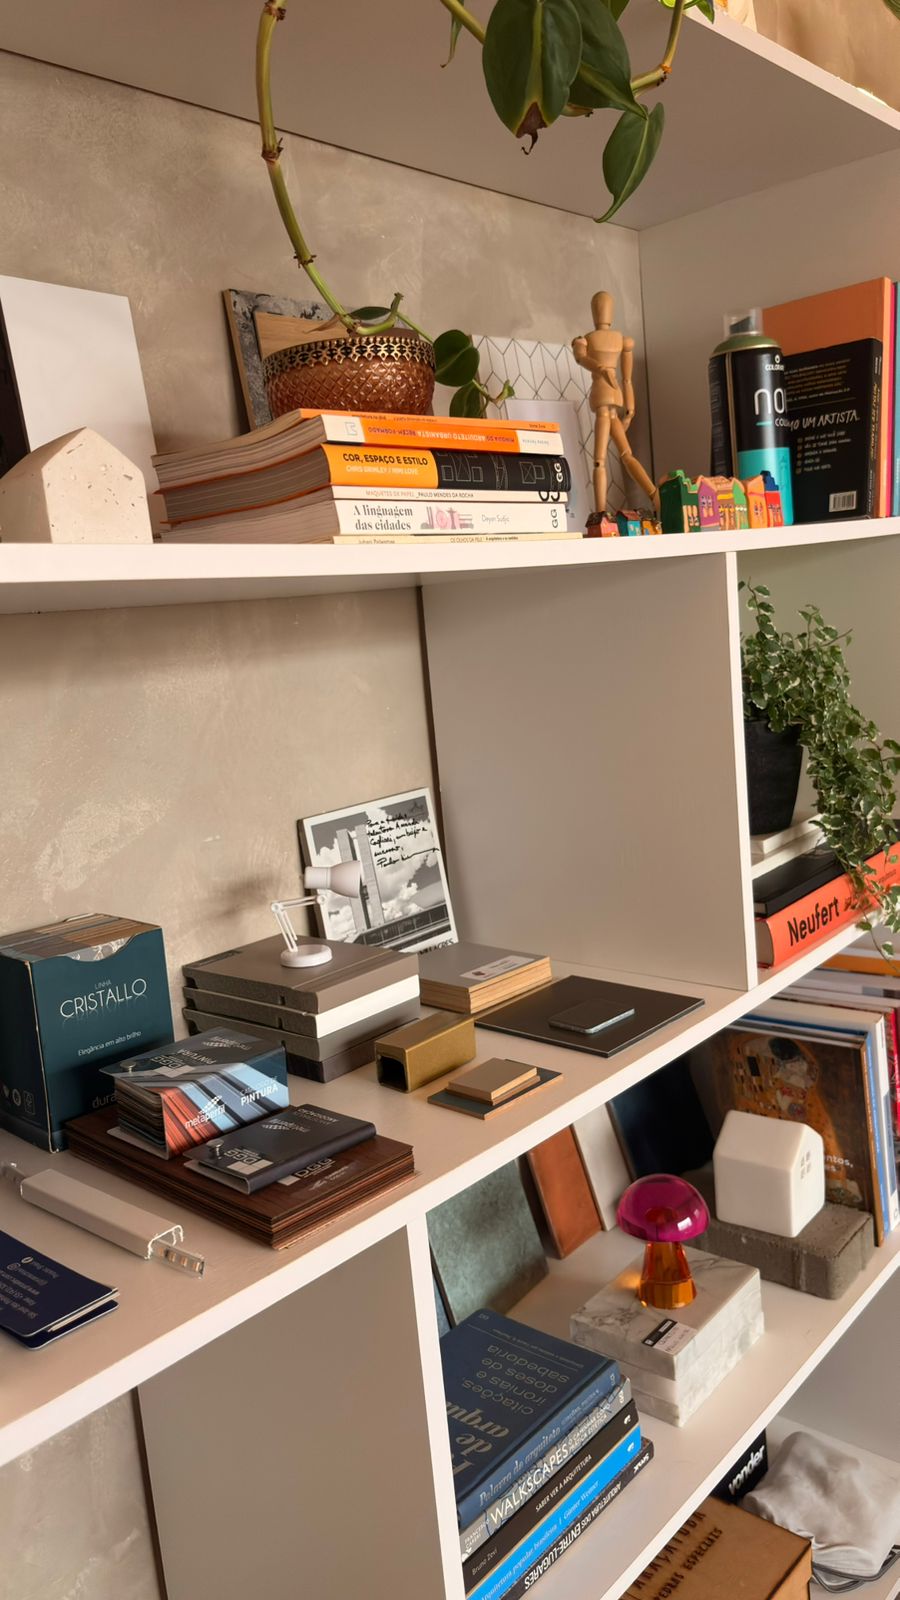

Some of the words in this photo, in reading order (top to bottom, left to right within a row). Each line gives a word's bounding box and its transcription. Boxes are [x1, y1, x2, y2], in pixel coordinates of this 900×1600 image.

[803, 415, 816, 428] UM
[343, 453, 363, 465] COR,
[365, 455, 395, 466] ESPAÇO
[403, 457, 428, 466] ESTILO
[354, 505, 361, 516] A
[362, 504, 413, 519] linguagem
[355, 520, 372, 531] das
[374, 519, 412, 531] cidades
[787, 896, 840, 946] Neufert
[60, 978, 147, 1019] CRISTALLO
[78, 1043, 105, 1057] Elegância
[105, 1040, 114, 1049] em
[115, 1036, 126, 1046] alto
[126, 1031, 142, 1042] brilho
[240, 1084, 279, 1106] PINTURA
[184, 1104, 226, 1130] metaperfil
[476, 1370, 487, 1378] e
[482, 1357, 502, 1371] de
[488, 1345, 570, 1383] sabedoria
[489, 1376, 546, 1406] ironias
[505, 1367, 558, 1393] doses
[456, 1433, 493, 1456] de
[491, 1443, 568, 1524] WALKSCAPES
[535, 1494, 550, 1512] SABER
[550, 1486, 559, 1498] VER
[563, 1454, 592, 1485] ARQUITETURA
[729, 1445, 766, 1496] vonder
[591, 1480, 622, 1518] ARQUITETURA
[581, 1513, 592, 1529] DOS
[512, 1549, 534, 1574] popular
[524, 1526, 582, 1590] ENTRE-LUGARES
[683, 1527, 722, 1571] ESPECIAIS
[472, 1559, 487, 1576] Bruno
